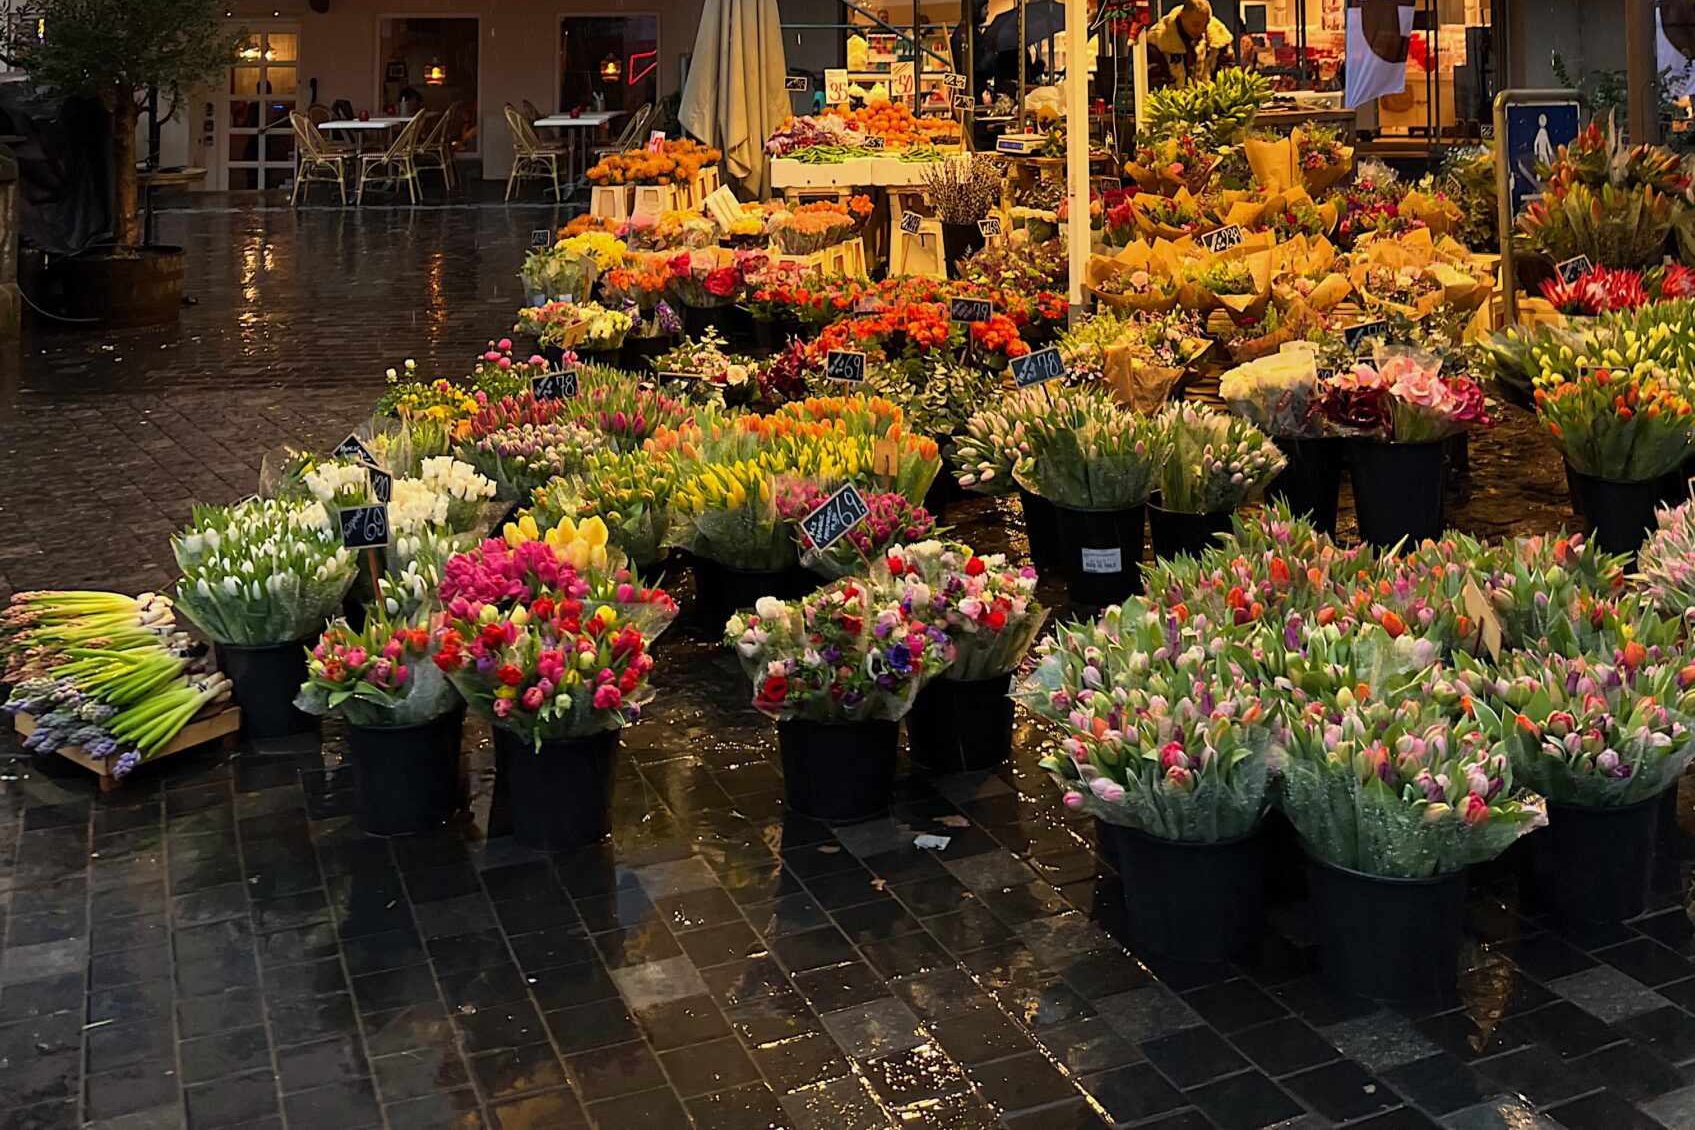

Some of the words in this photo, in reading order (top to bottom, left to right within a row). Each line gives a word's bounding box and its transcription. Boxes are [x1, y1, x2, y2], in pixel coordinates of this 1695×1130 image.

[829, 81, 849, 102] 35
[895, 74, 914, 95] 50
[1036, 351, 1060, 379] 78
[555, 374, 575, 397] 78
[363, 506, 386, 542] 69
